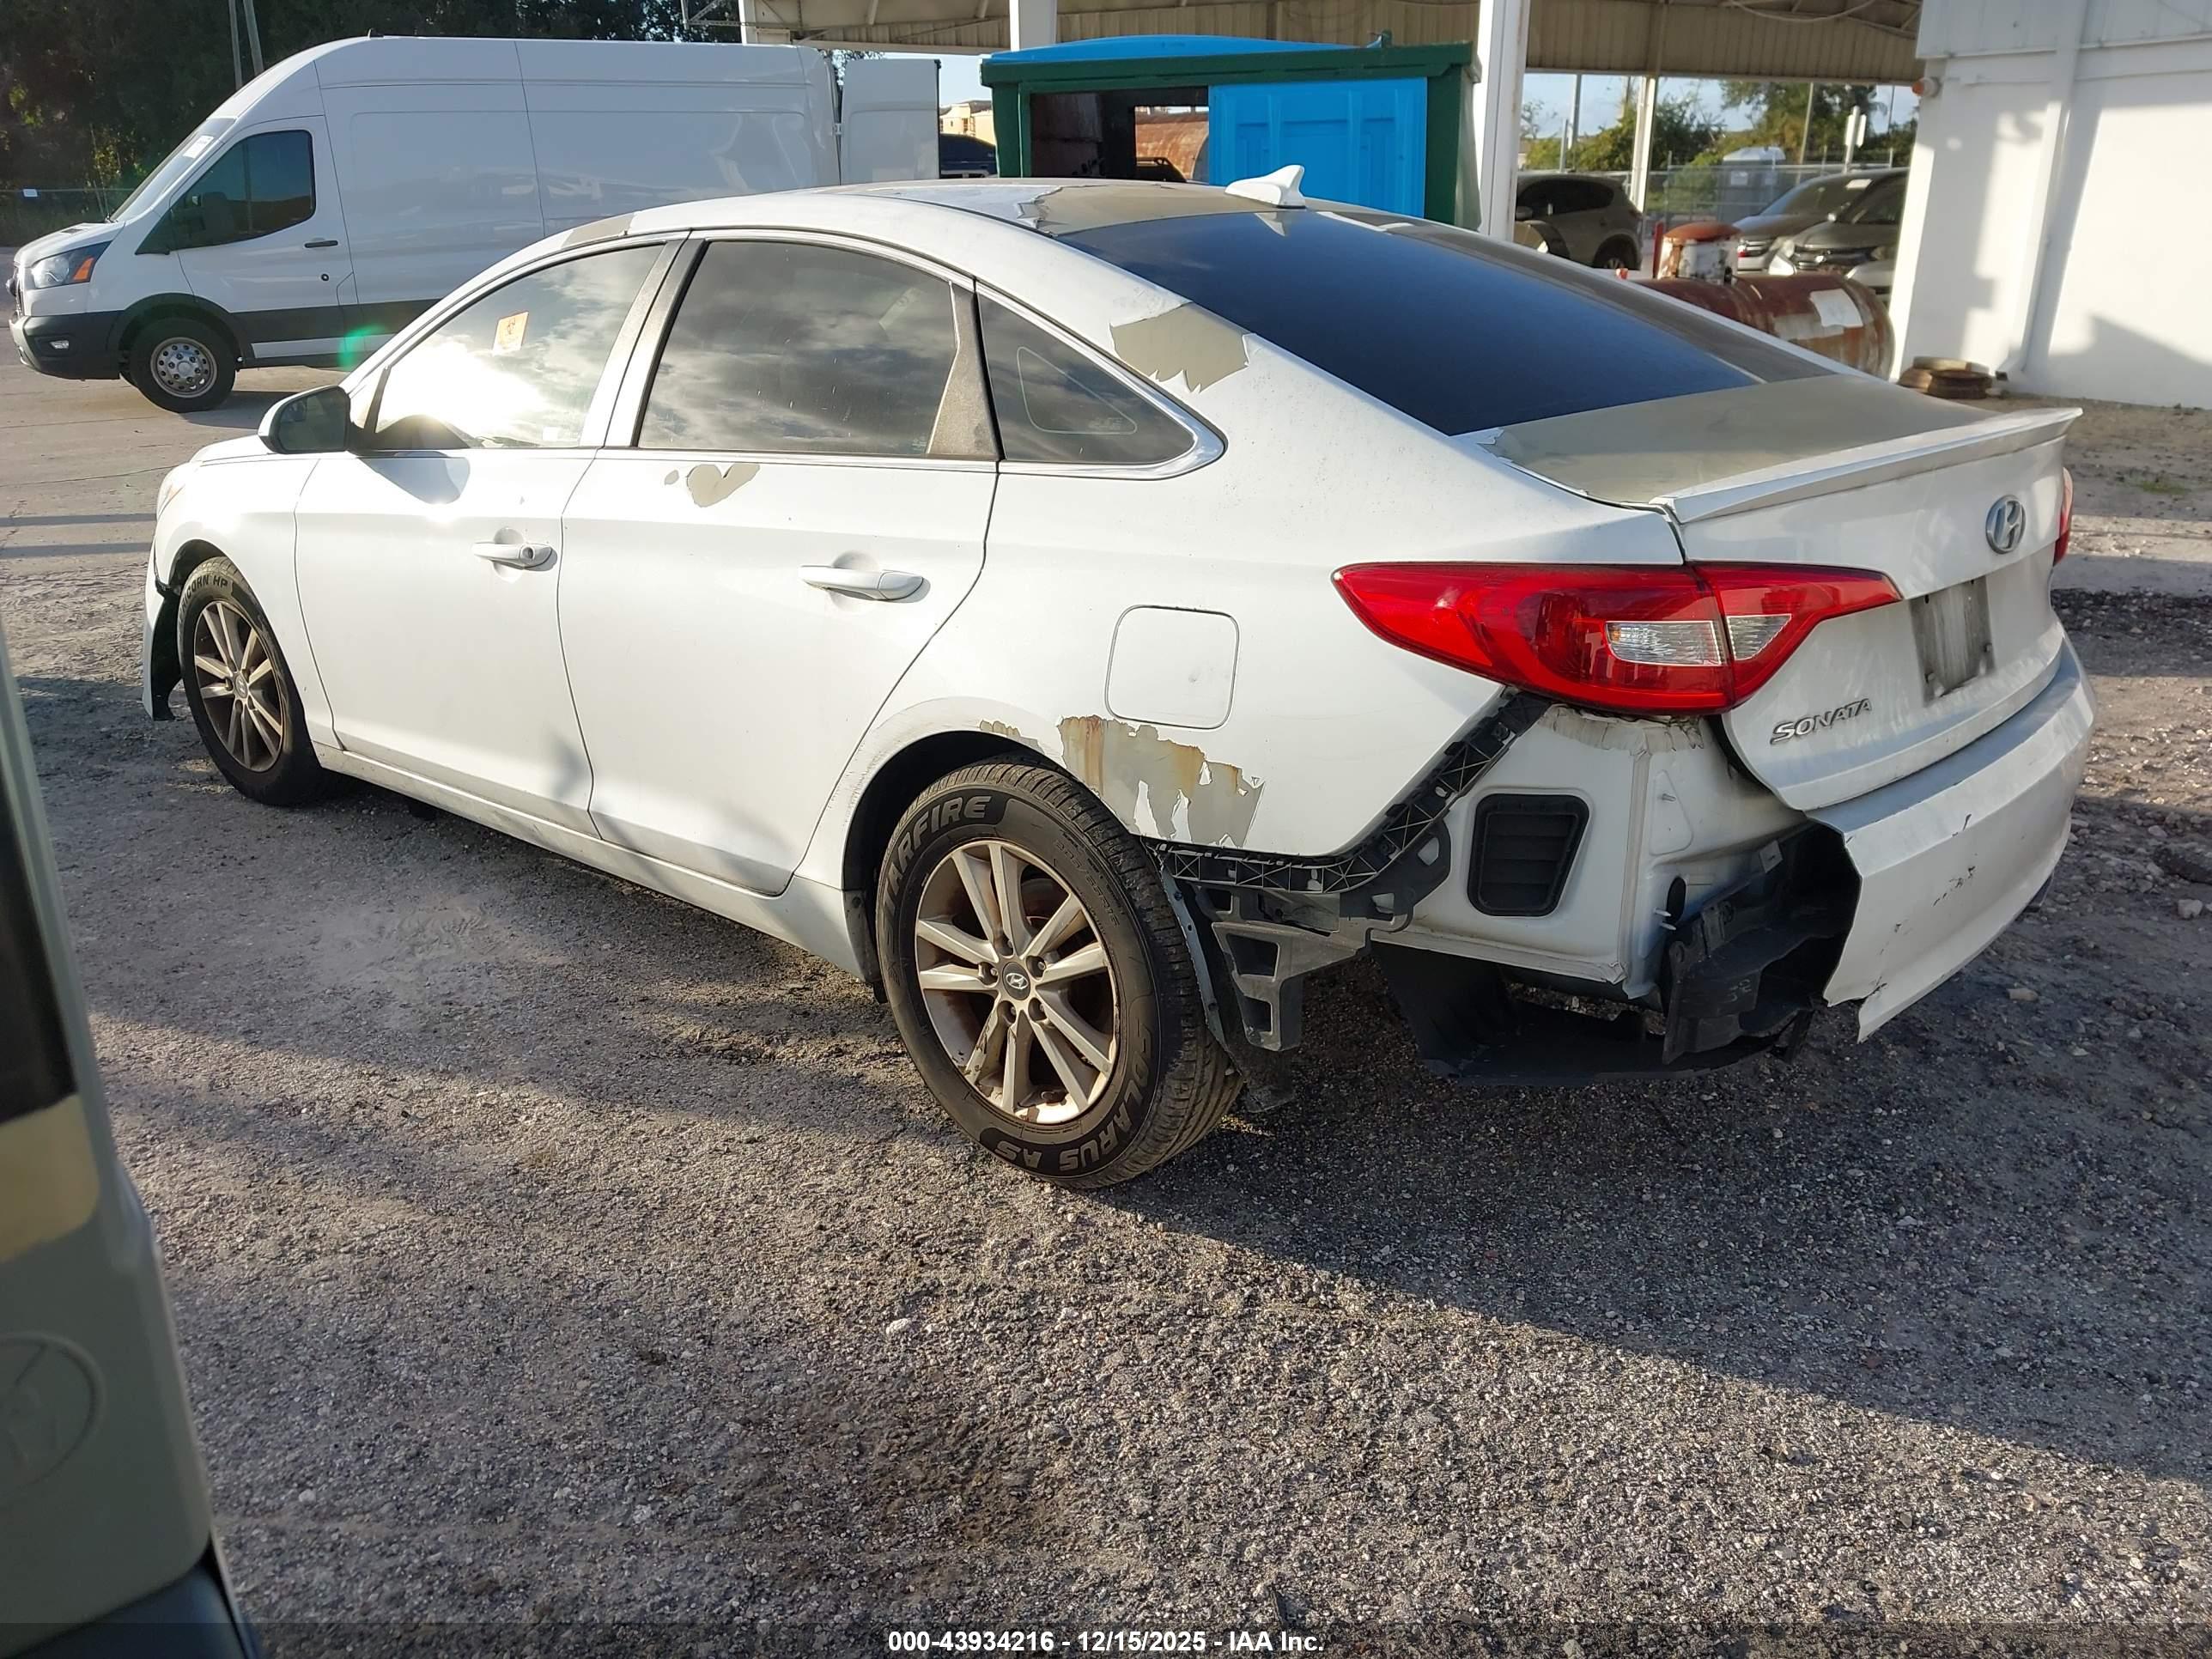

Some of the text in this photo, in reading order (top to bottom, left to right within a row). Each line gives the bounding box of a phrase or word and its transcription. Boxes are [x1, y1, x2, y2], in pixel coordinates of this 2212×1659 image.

[213, 575, 228, 588] HP
[1770, 698, 1872, 744] SONATA
[879, 795, 992, 955] STARFIRE
[994, 1017, 1152, 1171] SOLARUS AS
